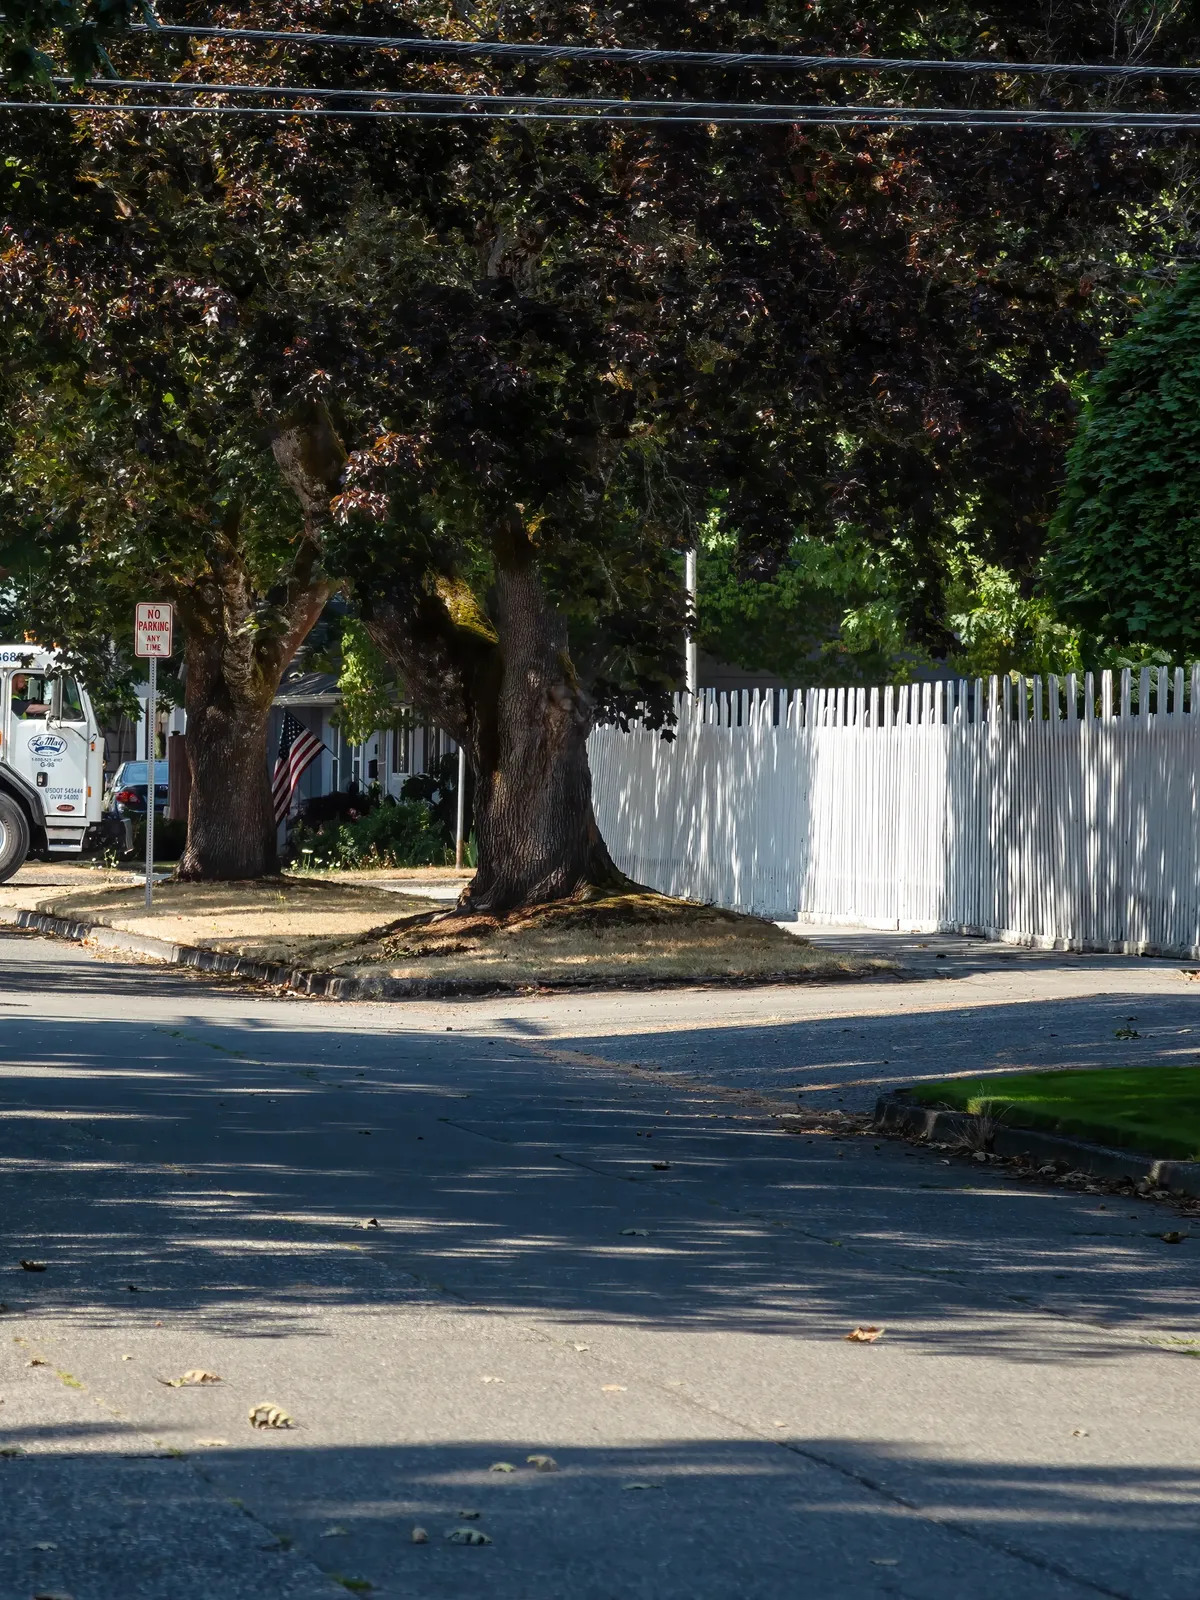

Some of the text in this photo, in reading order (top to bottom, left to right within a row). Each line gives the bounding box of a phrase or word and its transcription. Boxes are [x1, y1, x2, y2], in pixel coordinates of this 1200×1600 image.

[147, 609, 161, 619] NO
[138, 621, 170, 631] PARKING
[145, 643, 161, 651] TIME
